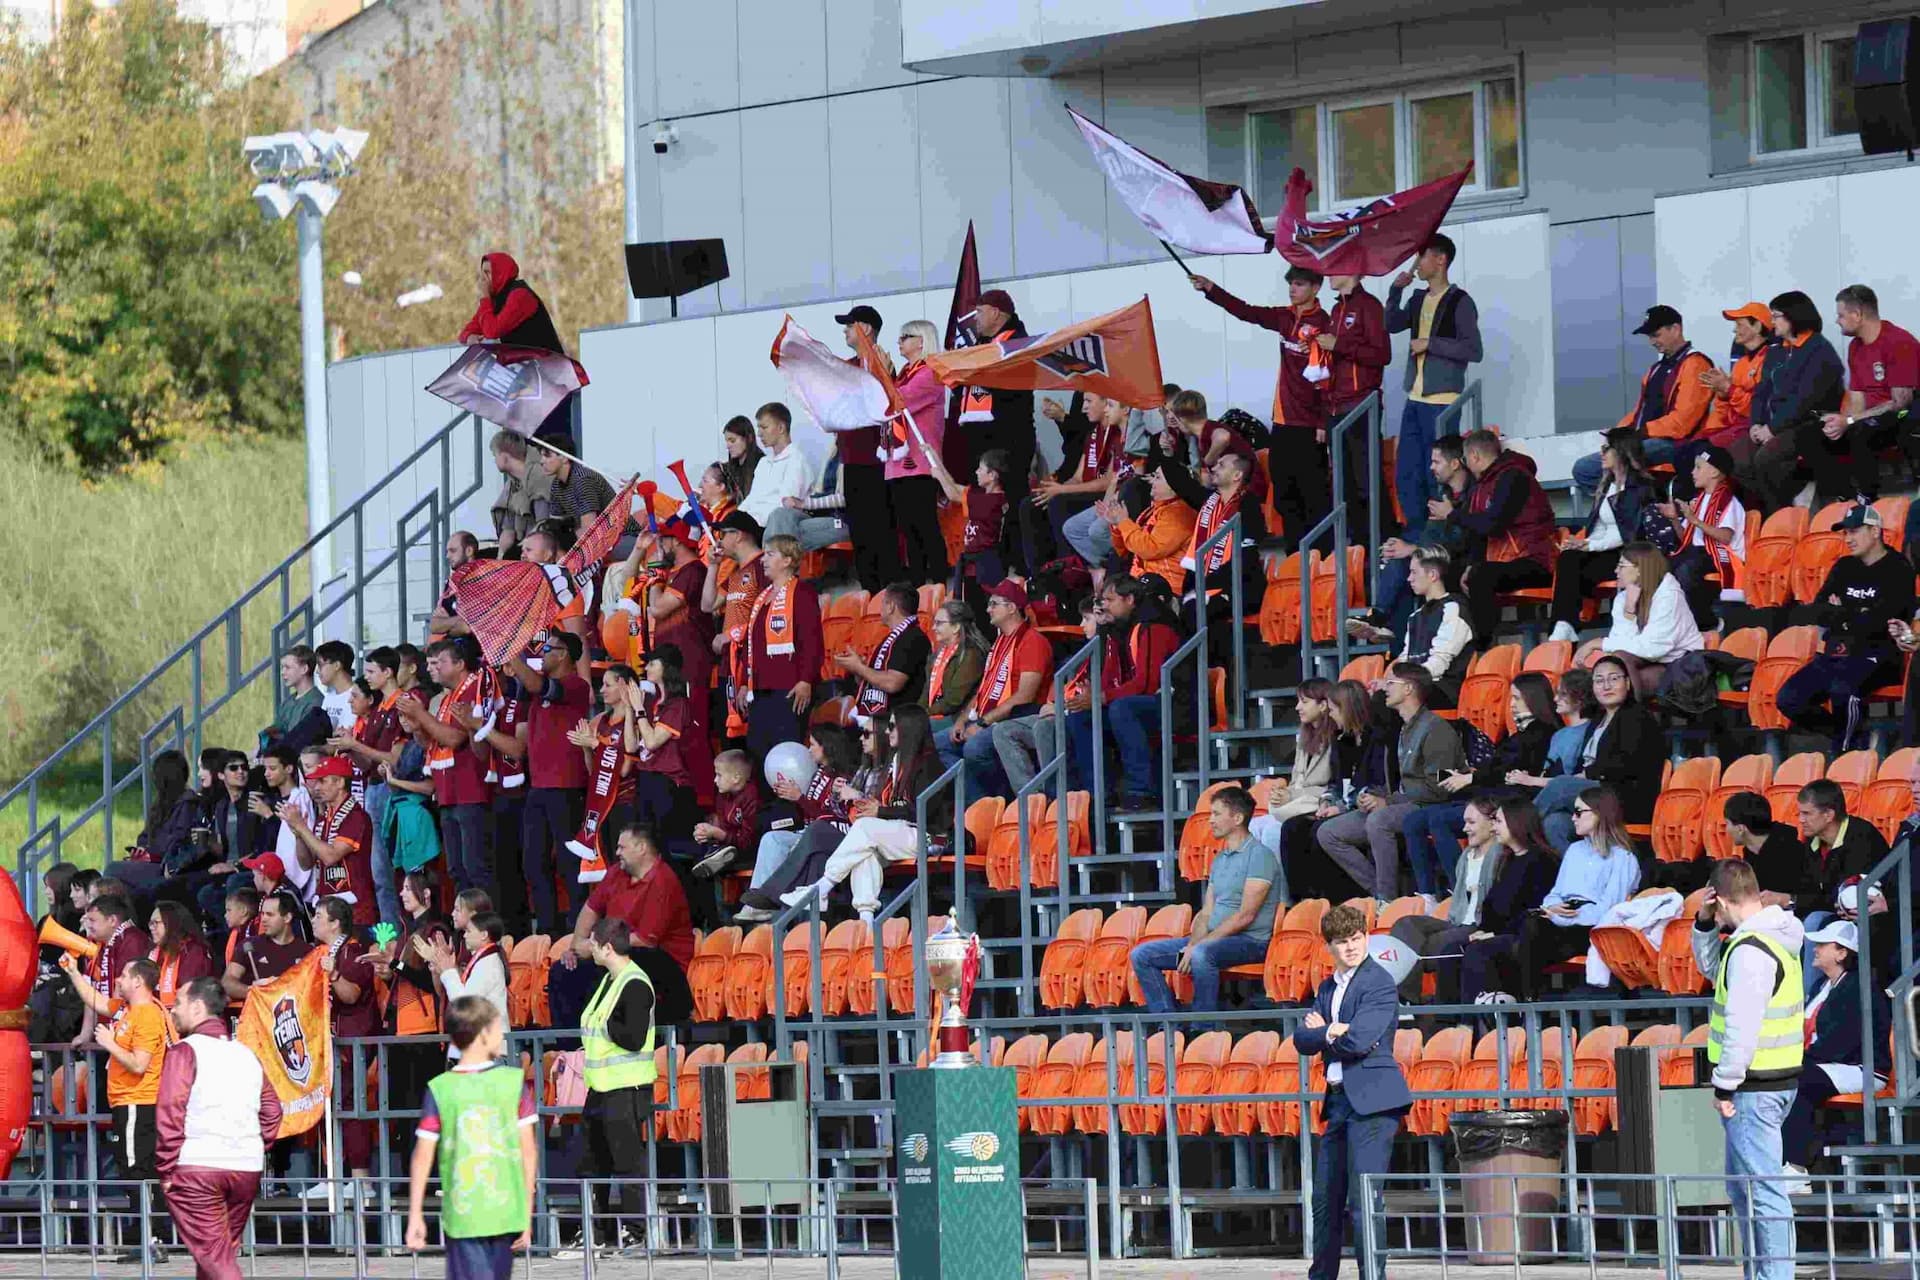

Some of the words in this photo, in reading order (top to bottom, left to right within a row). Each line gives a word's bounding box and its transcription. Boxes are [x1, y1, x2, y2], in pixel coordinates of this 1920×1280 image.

[595, 770, 613, 797] ТЕМП
[326, 866, 346, 880] ТЕМП
[274, 1017, 302, 1048] ТЕМП
